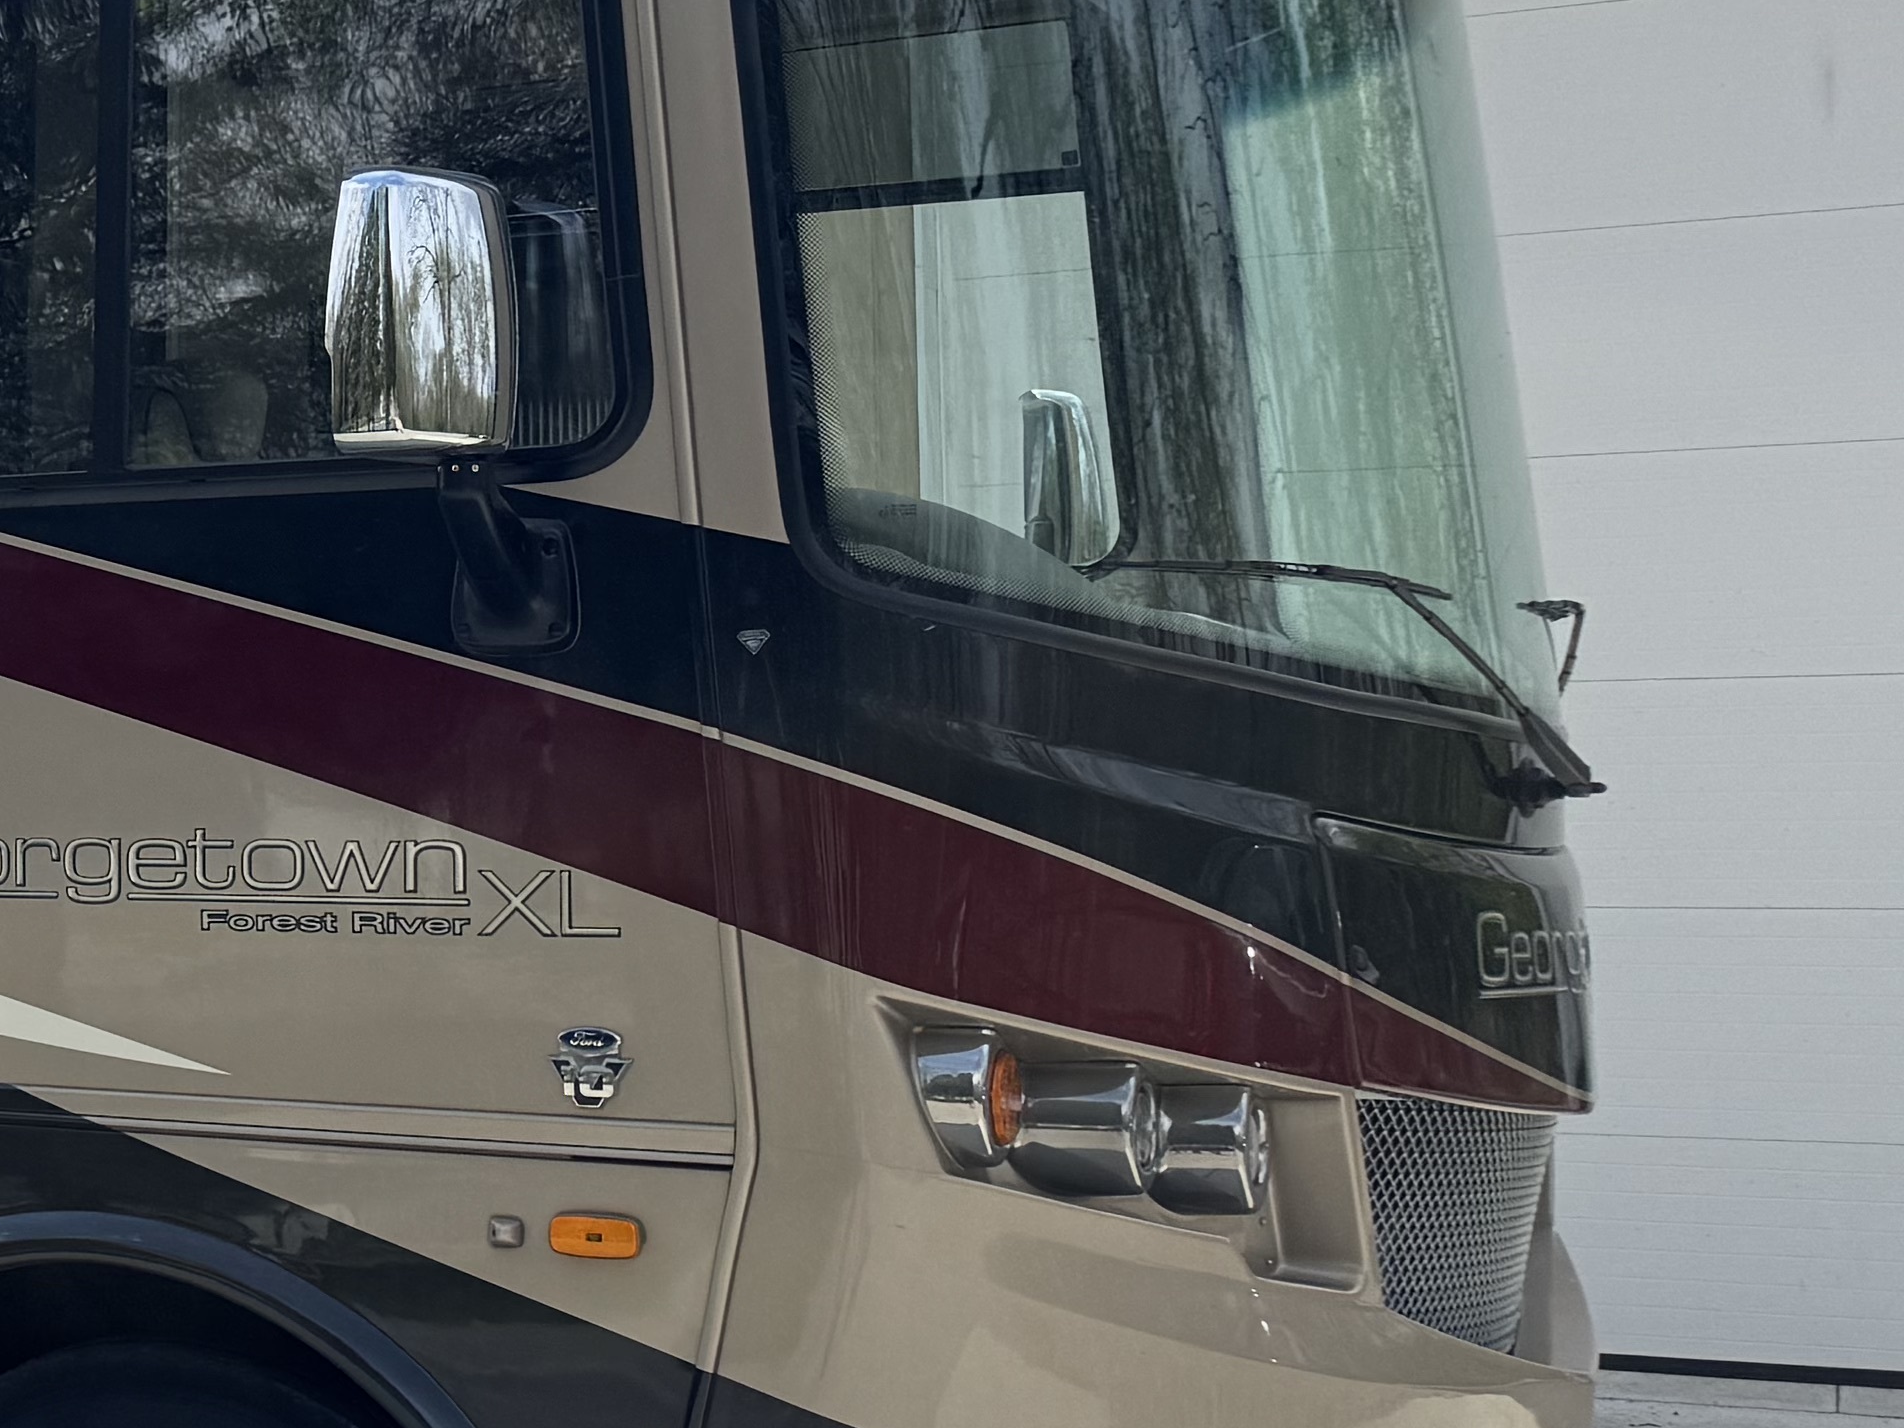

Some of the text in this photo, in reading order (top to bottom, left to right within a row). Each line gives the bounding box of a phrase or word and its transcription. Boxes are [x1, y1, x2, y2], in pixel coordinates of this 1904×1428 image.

[477, 869, 622, 938] XL
[200, 909, 472, 936] Forest River
[569, 1030, 605, 1047] Ford
